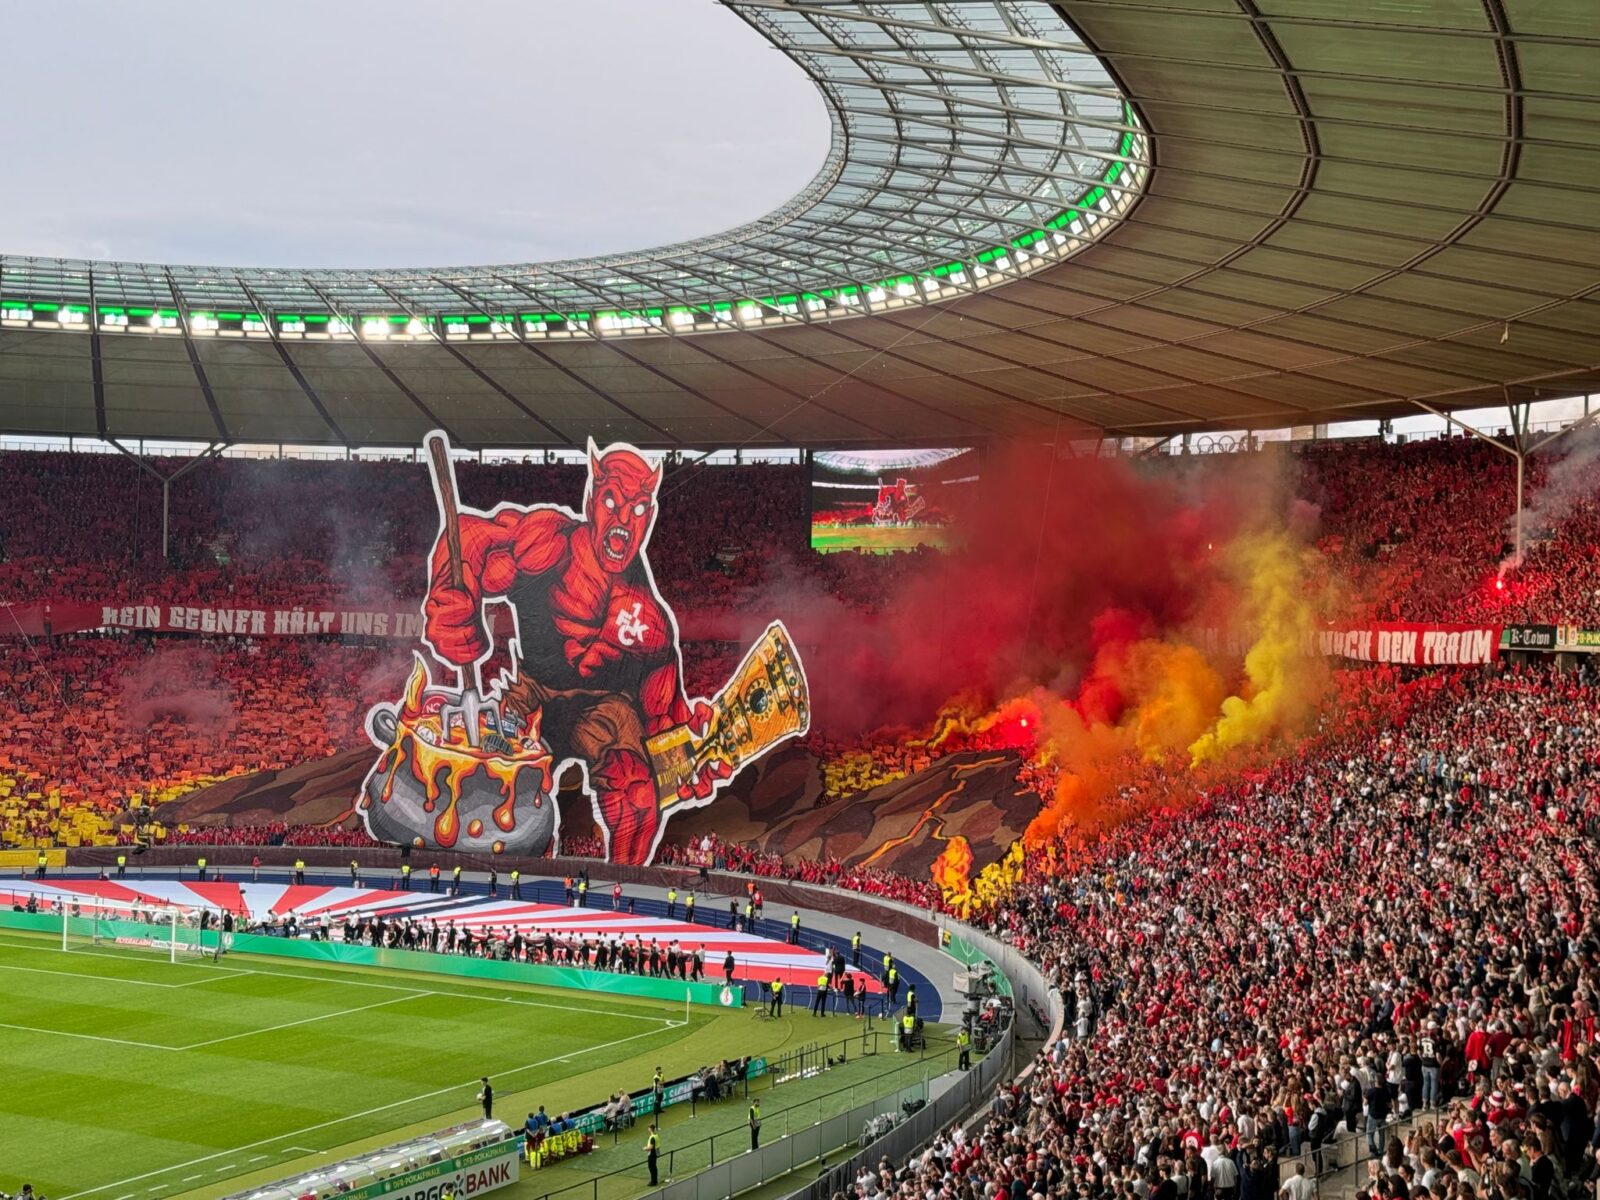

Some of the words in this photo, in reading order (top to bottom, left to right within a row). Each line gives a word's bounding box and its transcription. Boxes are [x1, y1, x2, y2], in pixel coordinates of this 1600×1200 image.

[168, 606, 266, 634] GEGNER
[273, 606, 335, 635] HÄLT
[341, 612, 389, 636] UNS
[1511, 628, 1550, 645] K-Town
[1423, 630, 1493, 665] TRAUM
[466, 1161, 510, 1194] BANK
